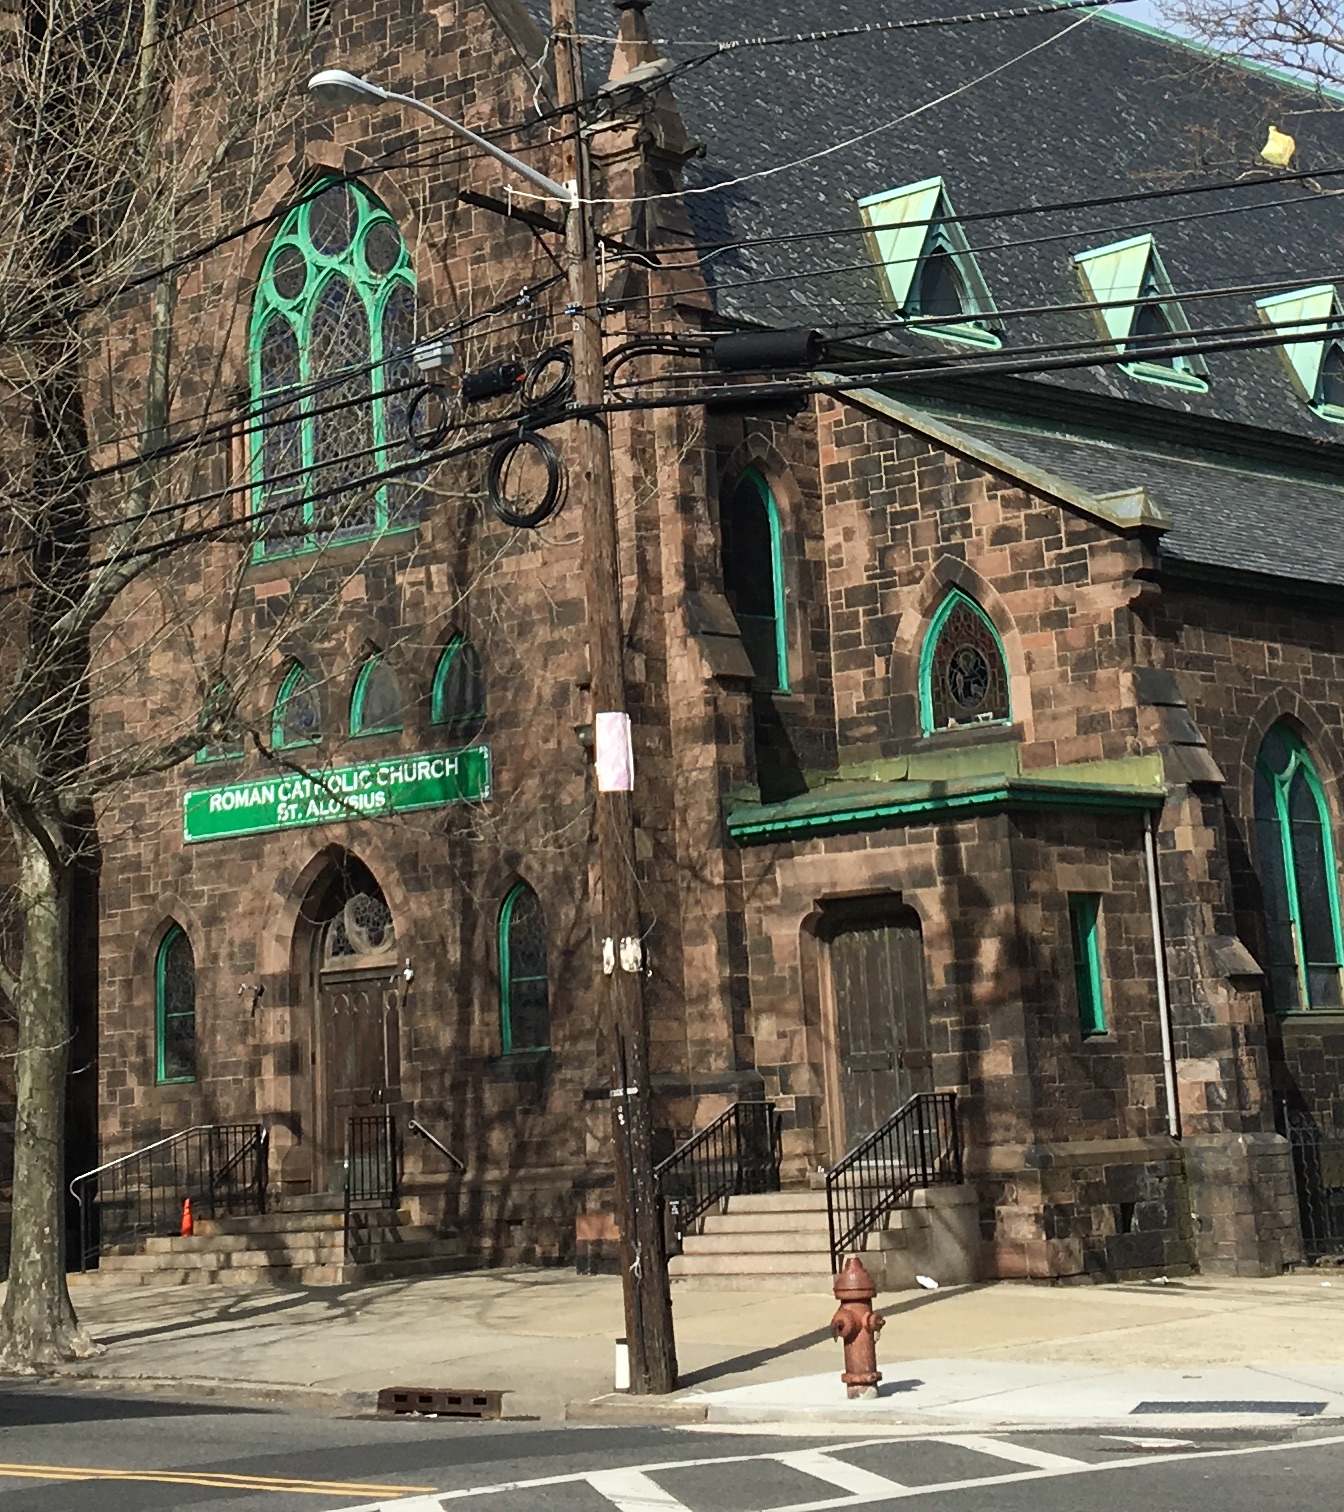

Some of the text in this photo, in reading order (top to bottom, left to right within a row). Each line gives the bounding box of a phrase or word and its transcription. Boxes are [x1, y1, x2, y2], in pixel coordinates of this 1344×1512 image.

[210, 785, 274, 813] ROMAN
[376, 757, 459, 786] CHURCH
[277, 803, 303, 821] ST.
